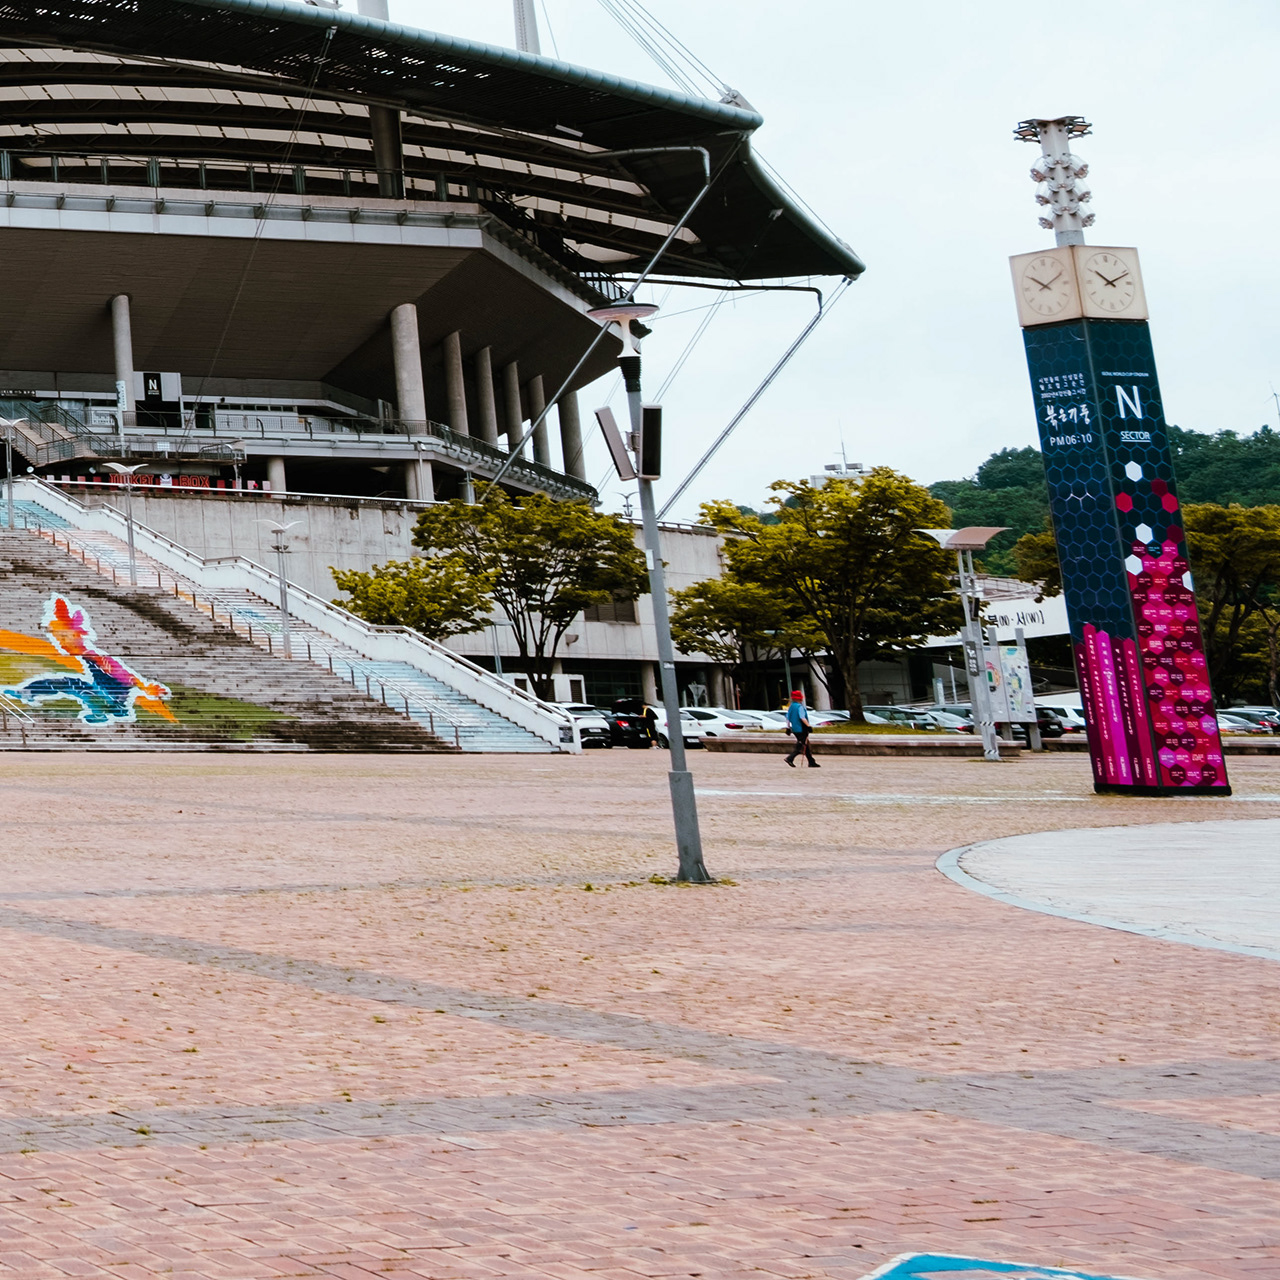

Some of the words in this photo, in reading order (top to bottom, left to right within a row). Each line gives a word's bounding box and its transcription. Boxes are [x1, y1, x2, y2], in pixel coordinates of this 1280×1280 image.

[148, 379, 158, 390] N
[1115, 384, 1142, 419] N
[1120, 431, 1151, 440] SECTOR
[180, 475, 210, 488] BOX
